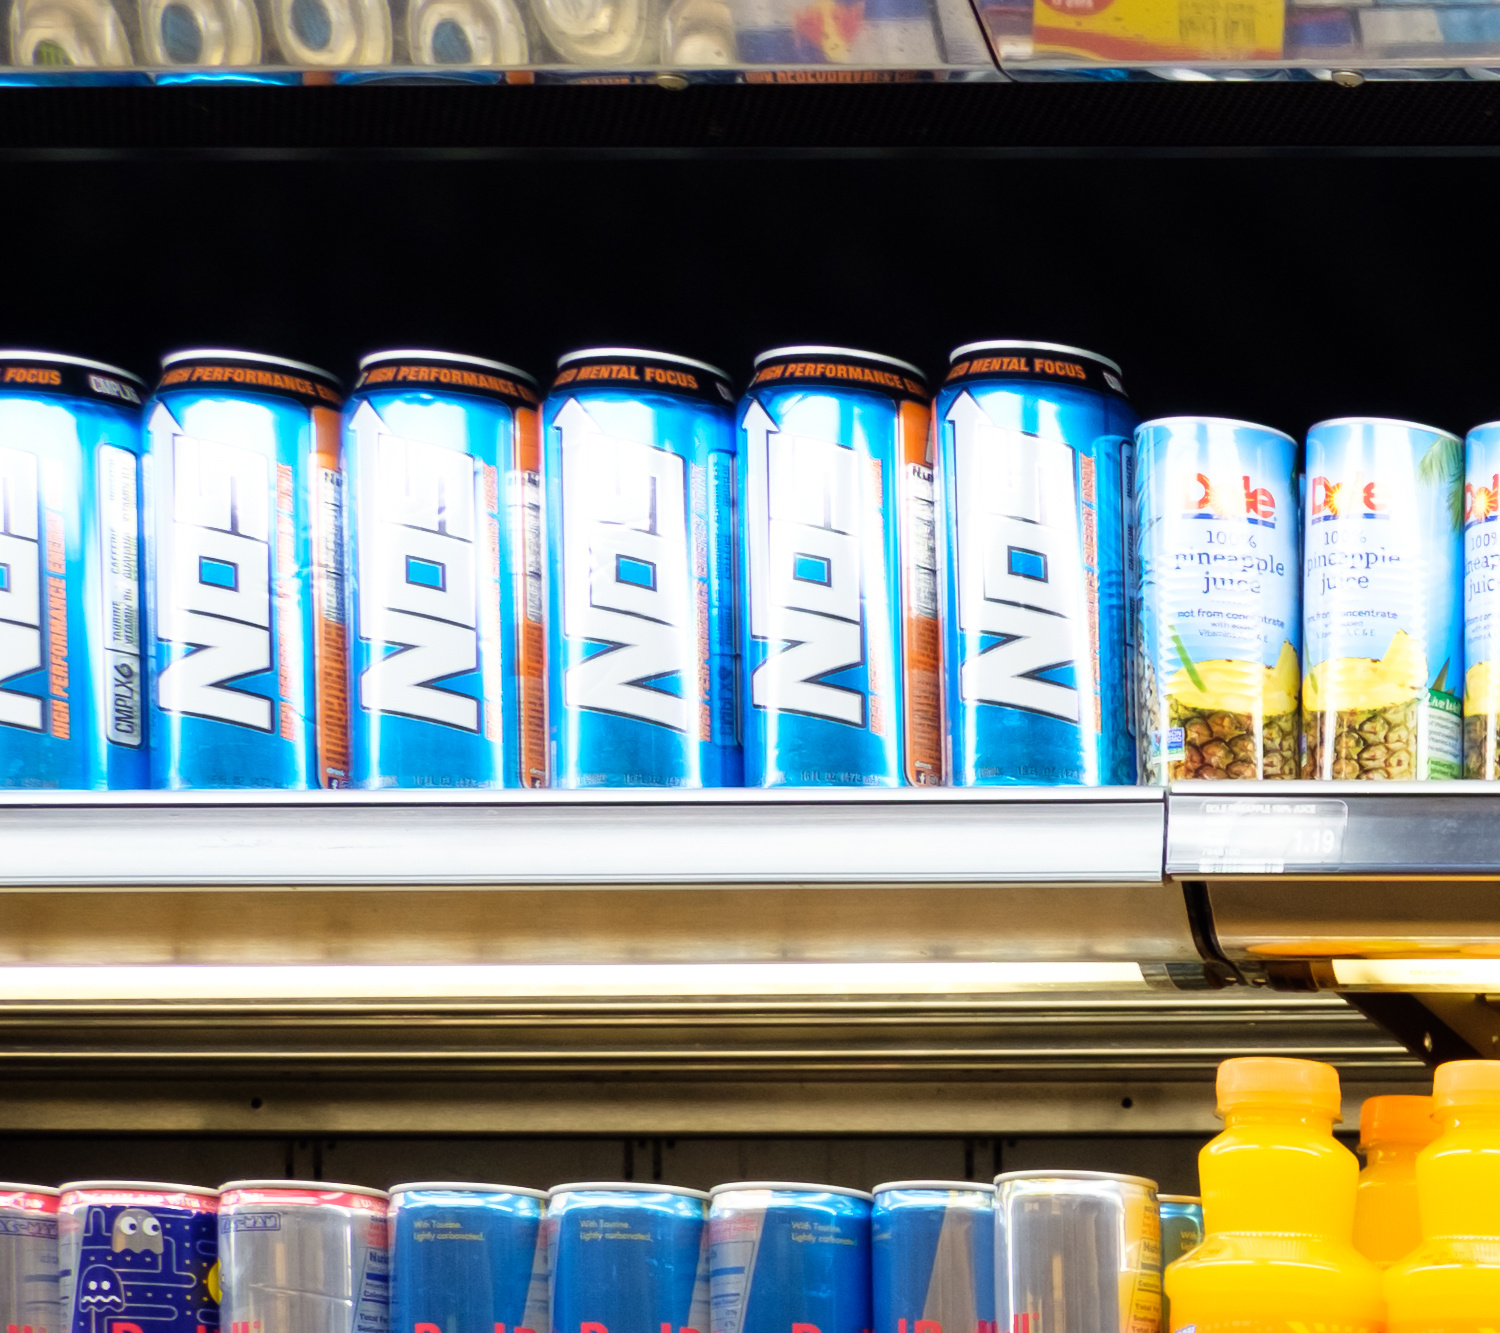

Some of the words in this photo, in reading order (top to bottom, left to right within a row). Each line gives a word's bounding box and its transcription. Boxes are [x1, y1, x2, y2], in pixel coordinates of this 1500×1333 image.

[784, 363, 903, 388] PERFORMANCE
[971, 357, 1029, 374] MENTAL
[1034, 359, 1087, 380] FOCUS
